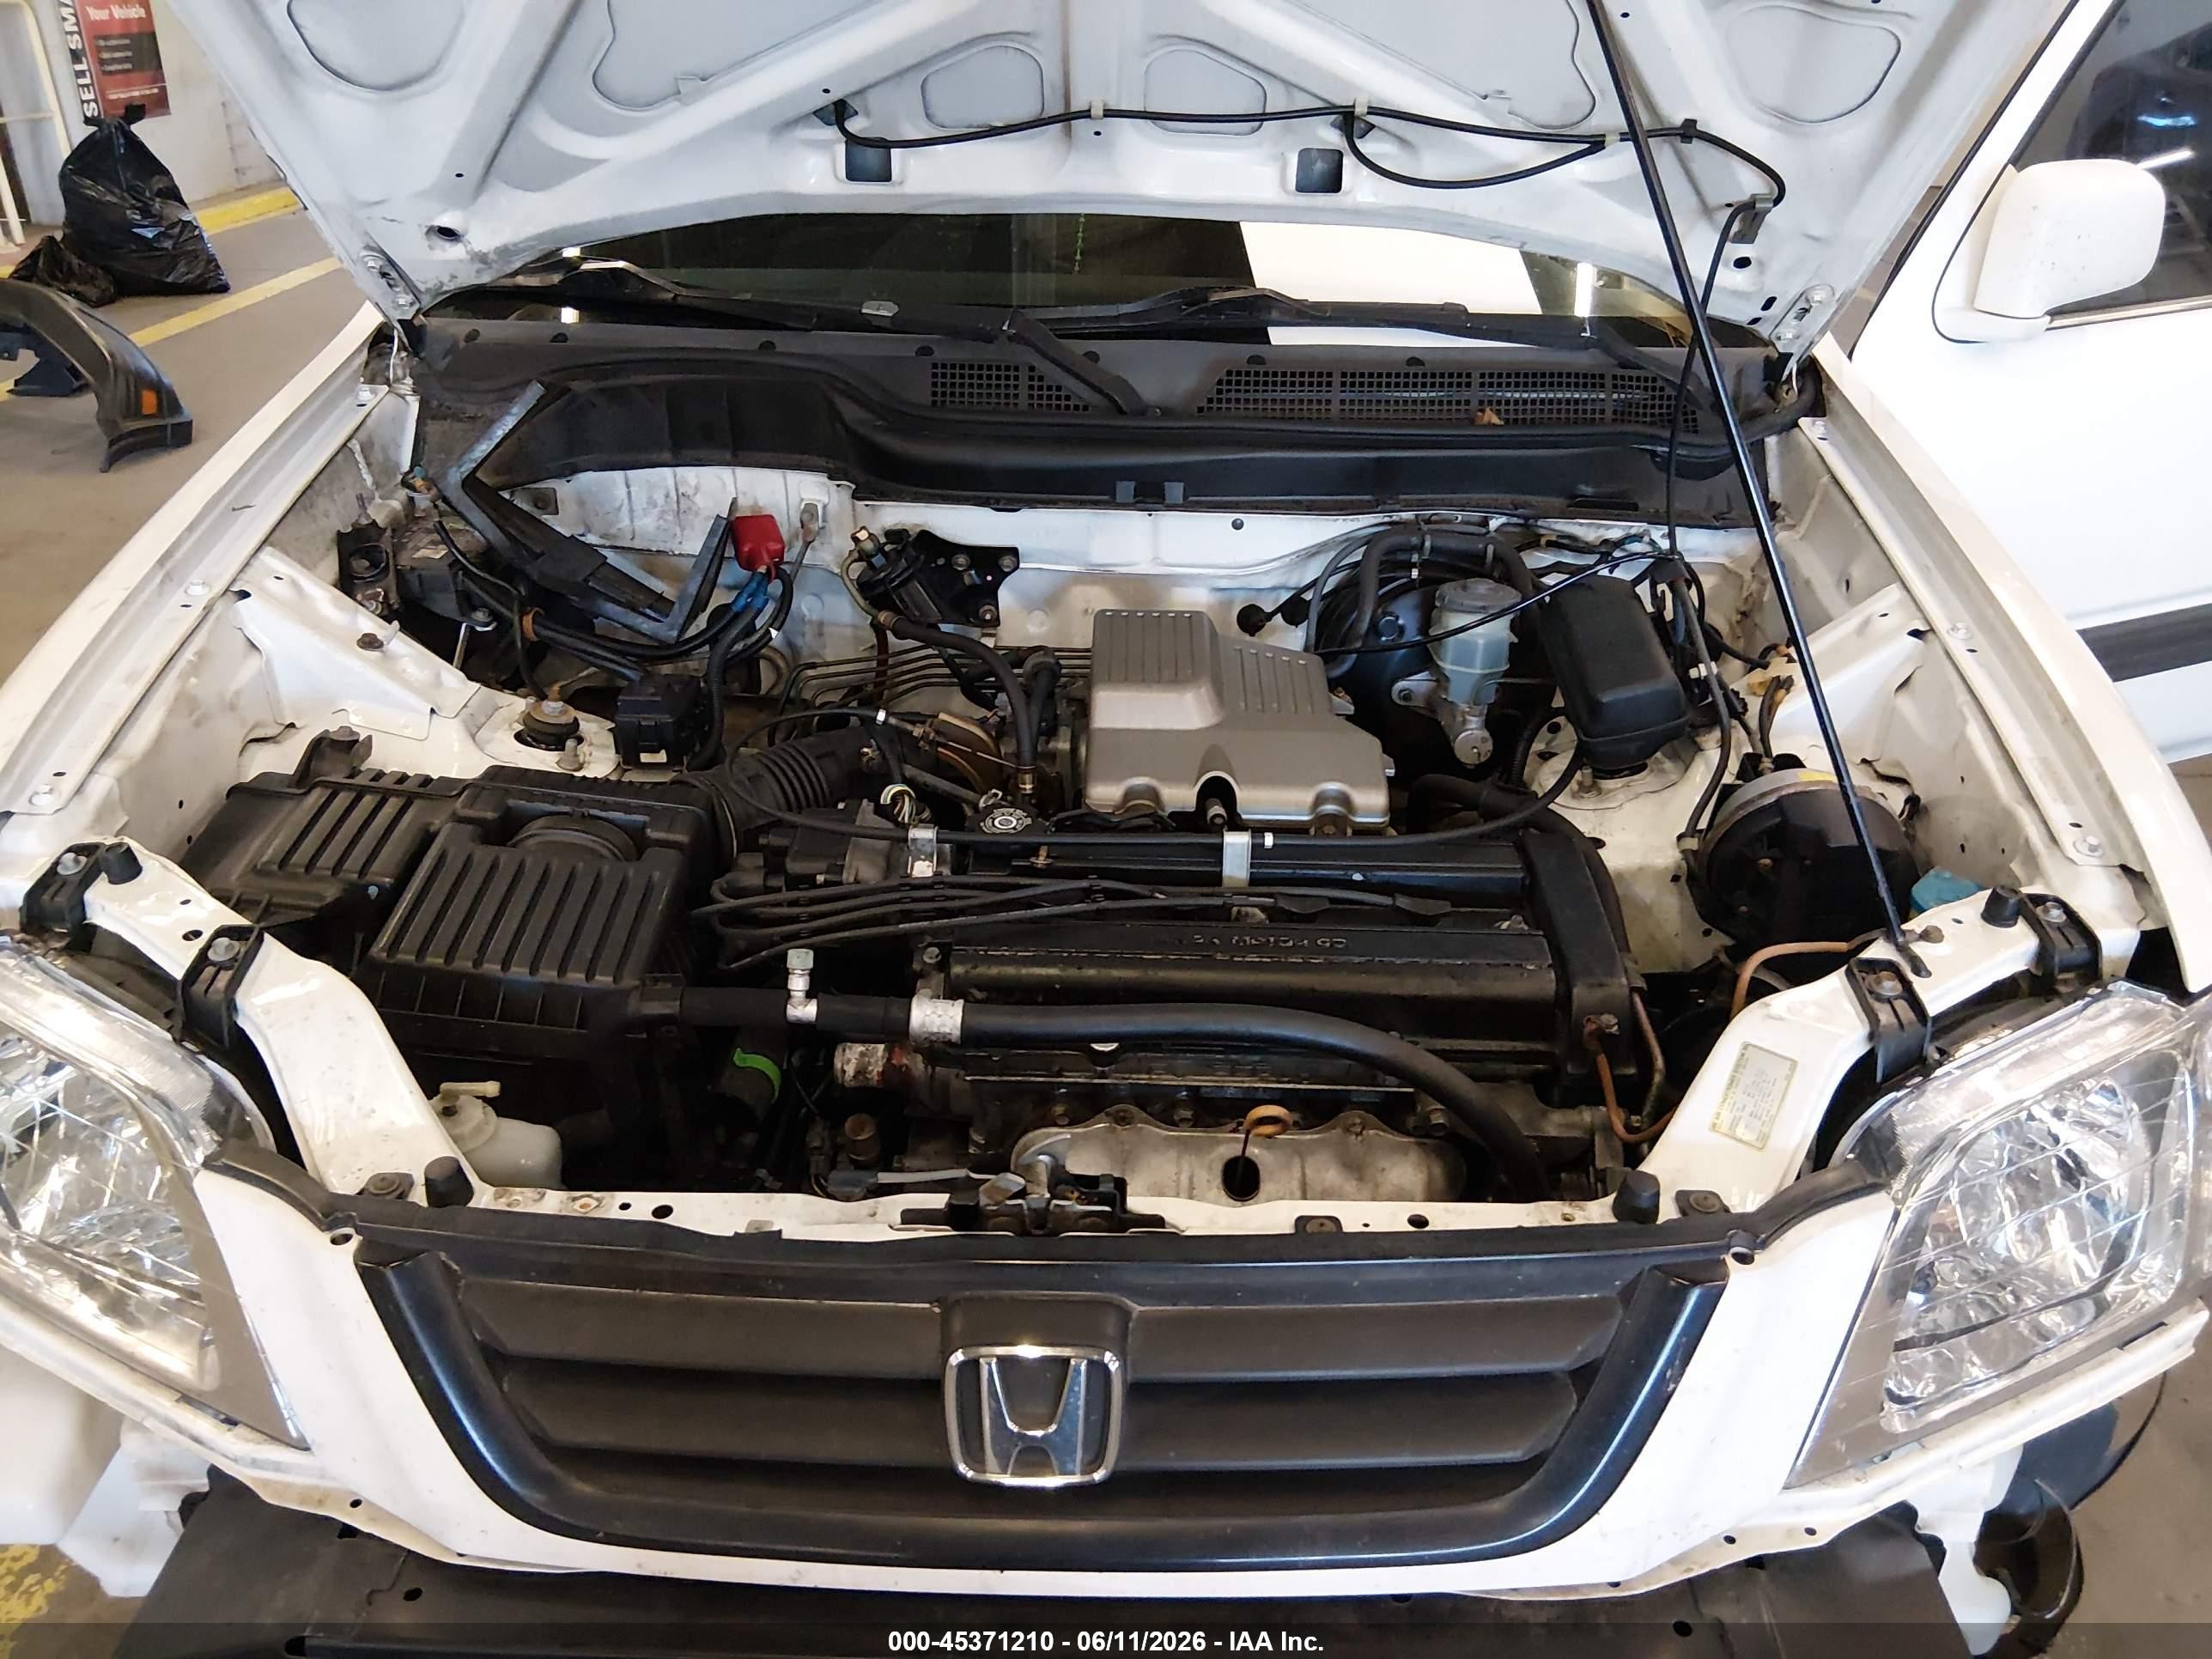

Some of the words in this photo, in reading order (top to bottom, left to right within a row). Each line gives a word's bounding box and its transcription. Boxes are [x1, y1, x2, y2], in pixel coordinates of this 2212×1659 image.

[87, 6, 111, 21] Your
[110, 4, 146, 20] Vehicle
[74, 57, 99, 118] SELL
